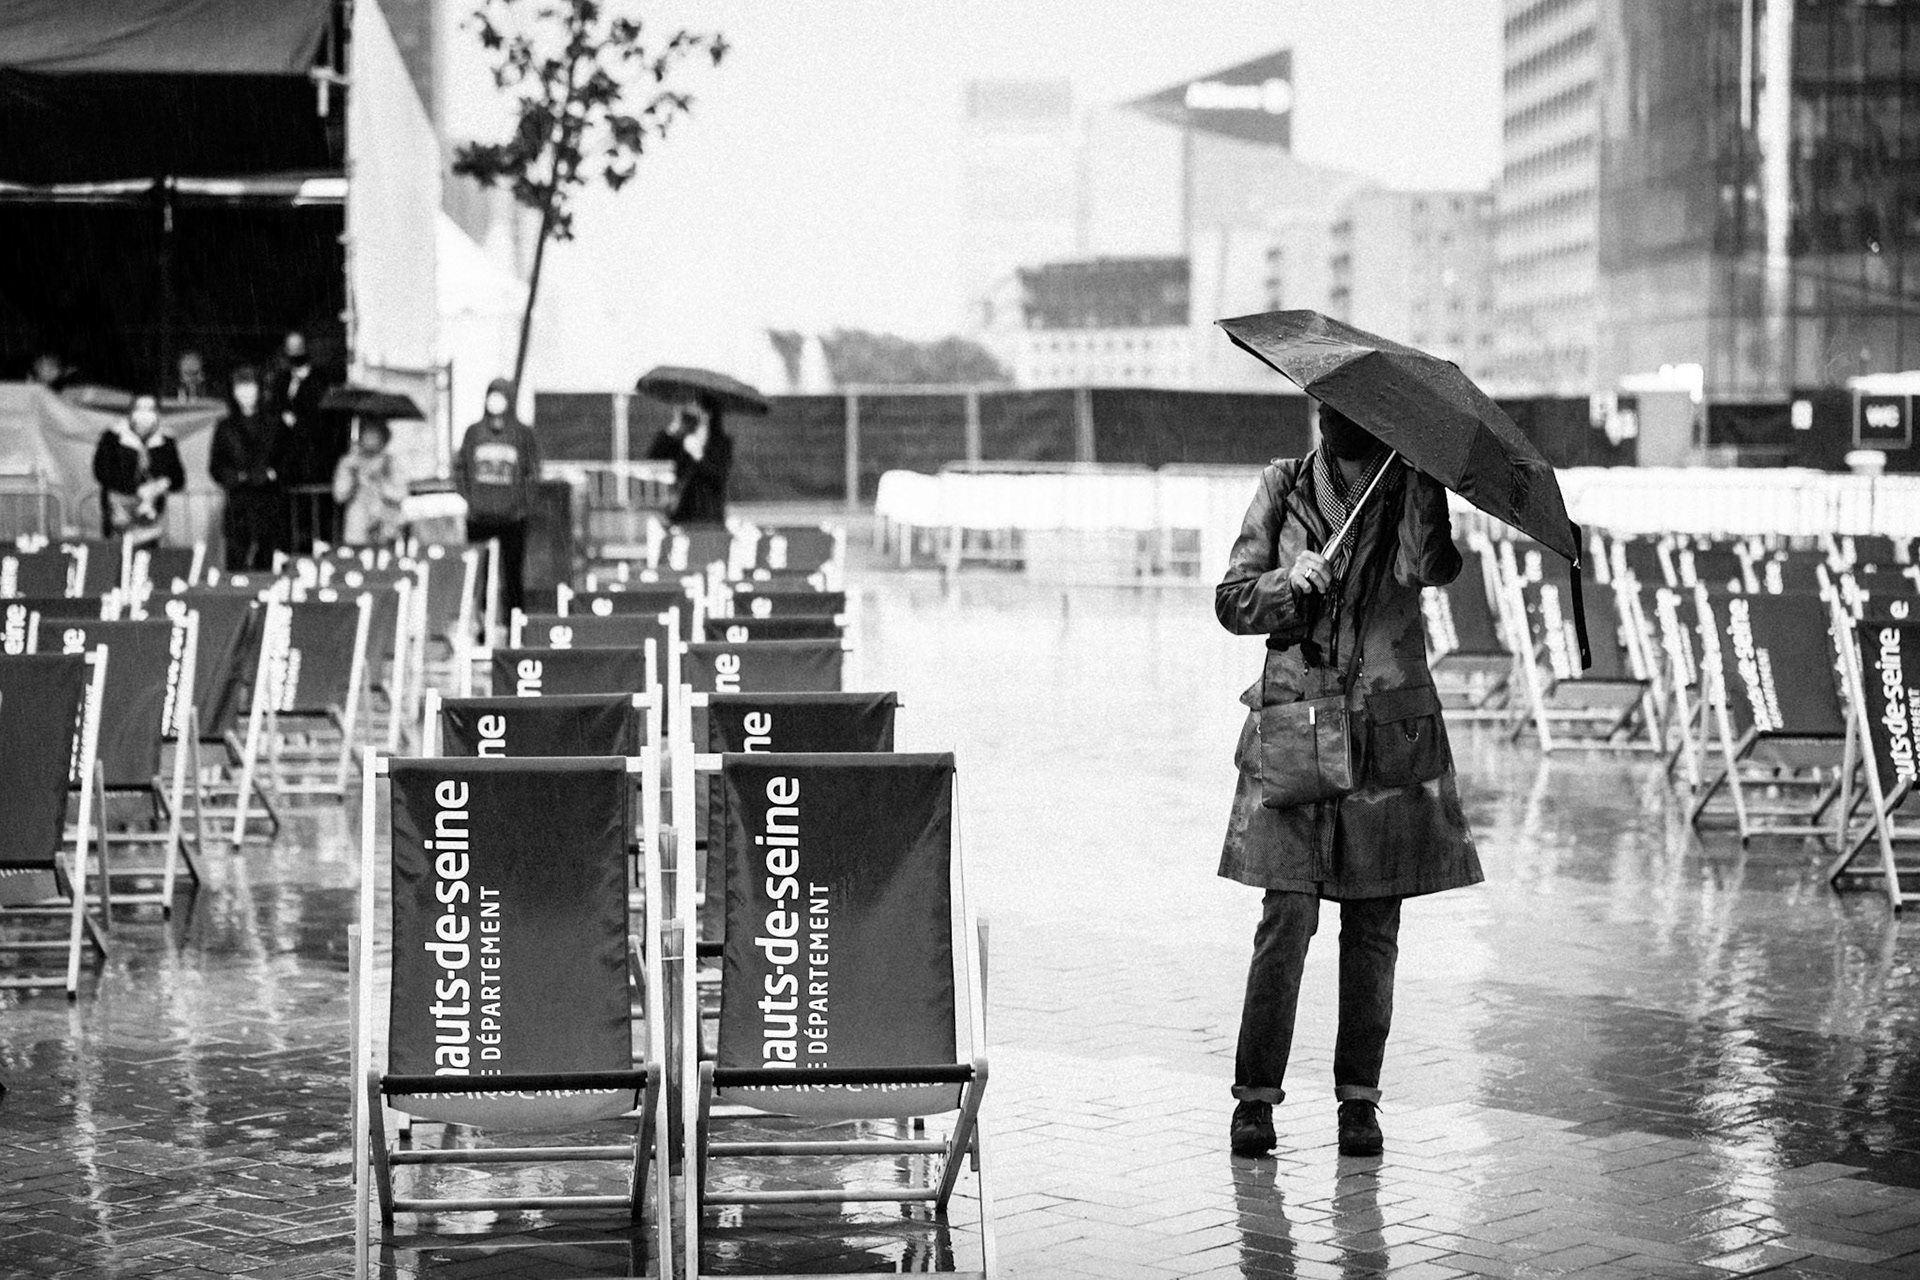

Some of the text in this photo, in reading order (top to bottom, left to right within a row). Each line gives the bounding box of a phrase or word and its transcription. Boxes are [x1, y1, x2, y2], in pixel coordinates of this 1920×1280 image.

[476, 886, 502, 1060] DÉPARTEMENT
[755, 775, 800, 1068] auts-de-seine
[803, 882, 829, 1054] DÉPARTEMENT
